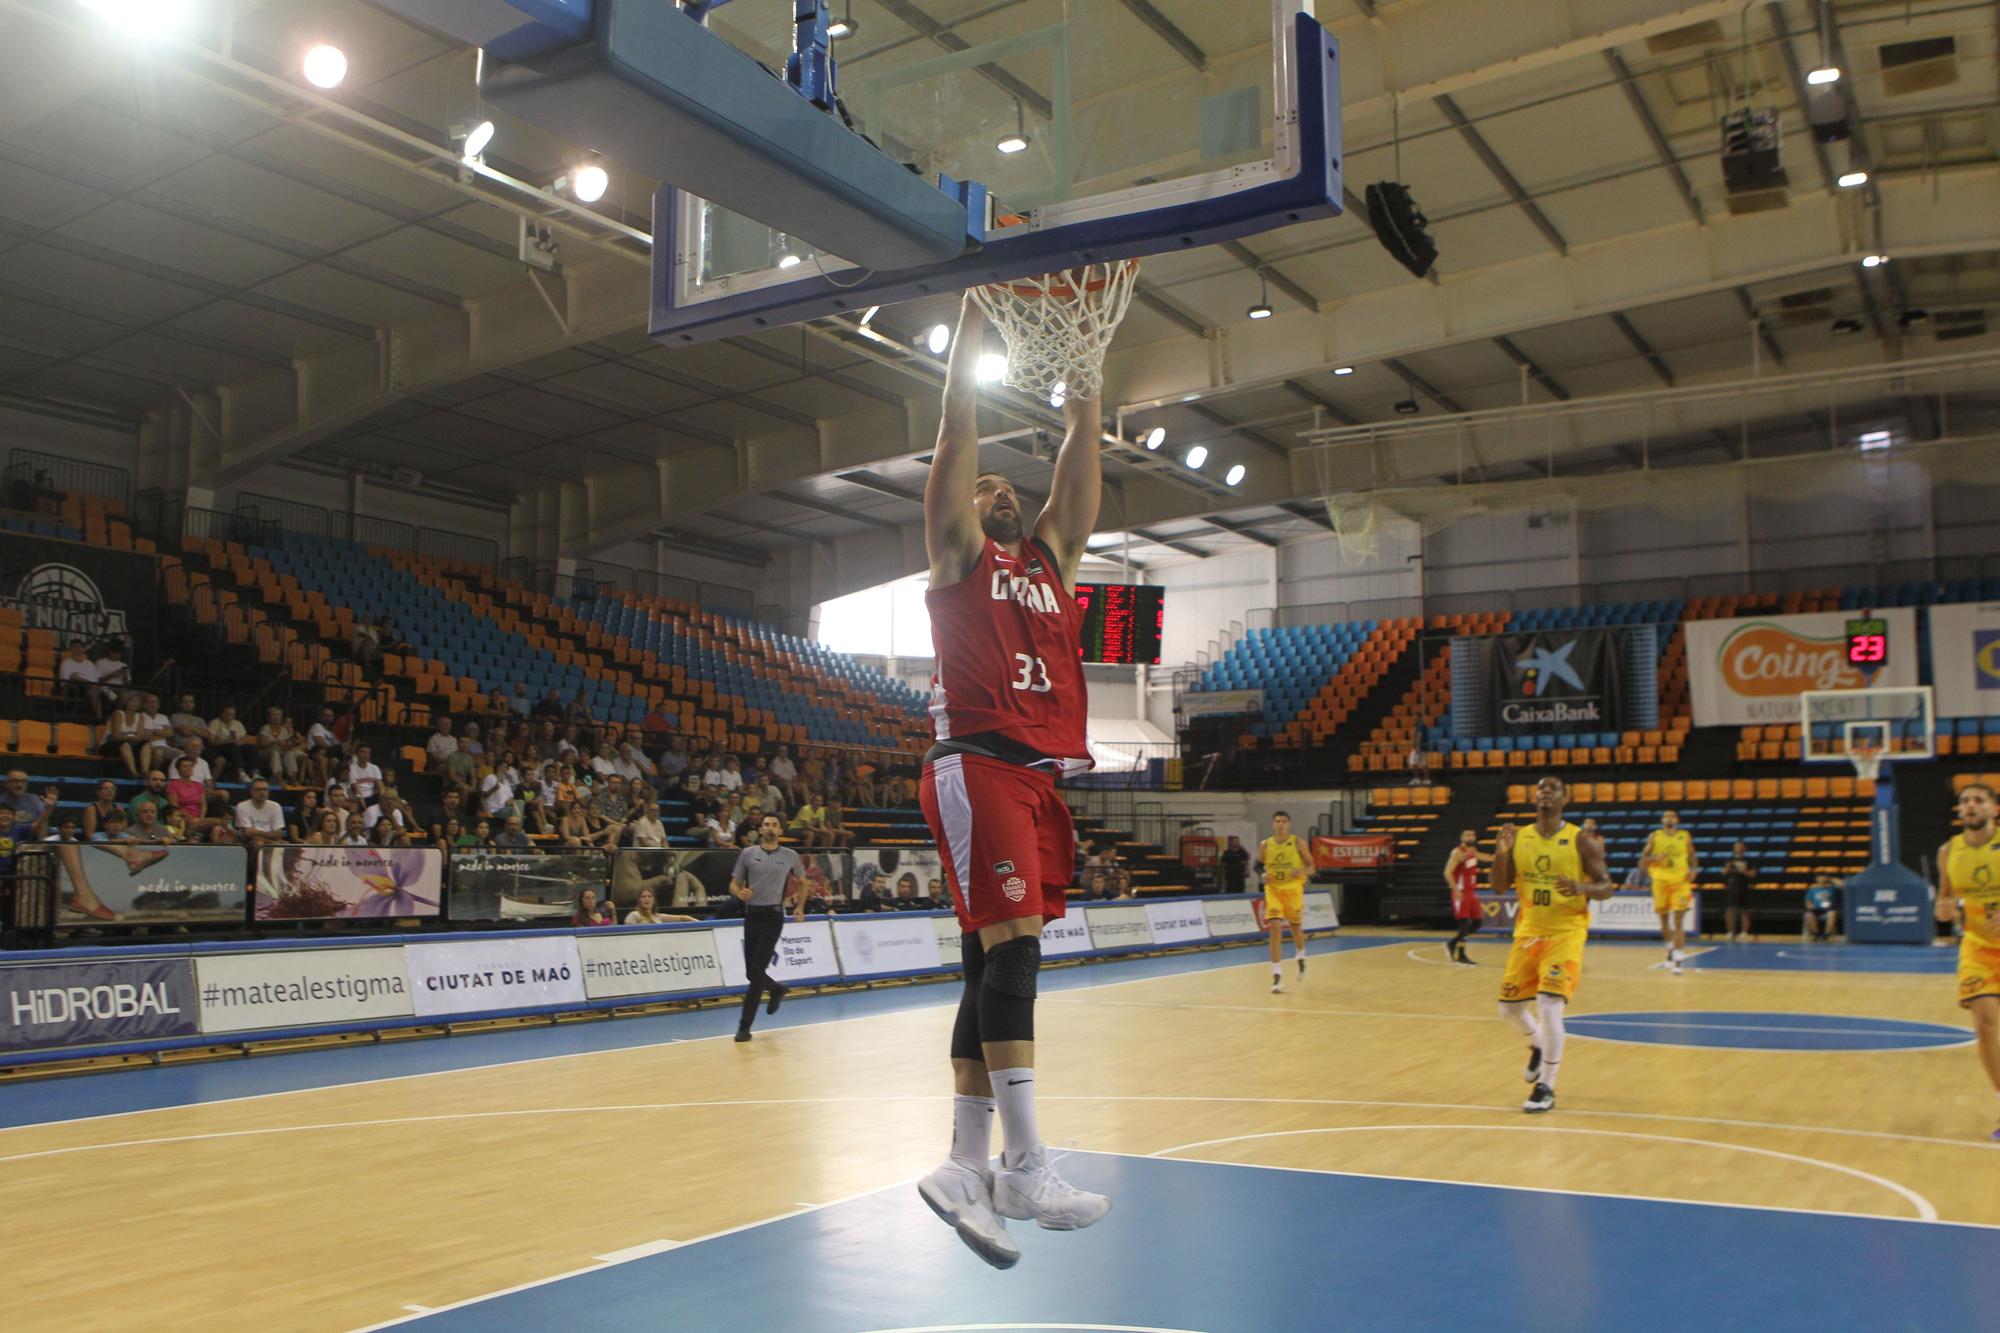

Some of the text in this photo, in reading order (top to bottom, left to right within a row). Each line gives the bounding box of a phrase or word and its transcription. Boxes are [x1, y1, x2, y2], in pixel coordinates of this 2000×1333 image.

[1849, 634, 1885, 663] 23
[1012, 652, 1052, 693] 33
[1502, 701, 1600, 724] CaixaBank
[1533, 888, 1551, 906] 00
[426, 962, 571, 991] CIUTAT DE MAÓ
[585, 952, 715, 978] #matealestigma
[11, 982, 181, 1026] HiDROBAL
[203, 974, 405, 1008] #matealestigma
